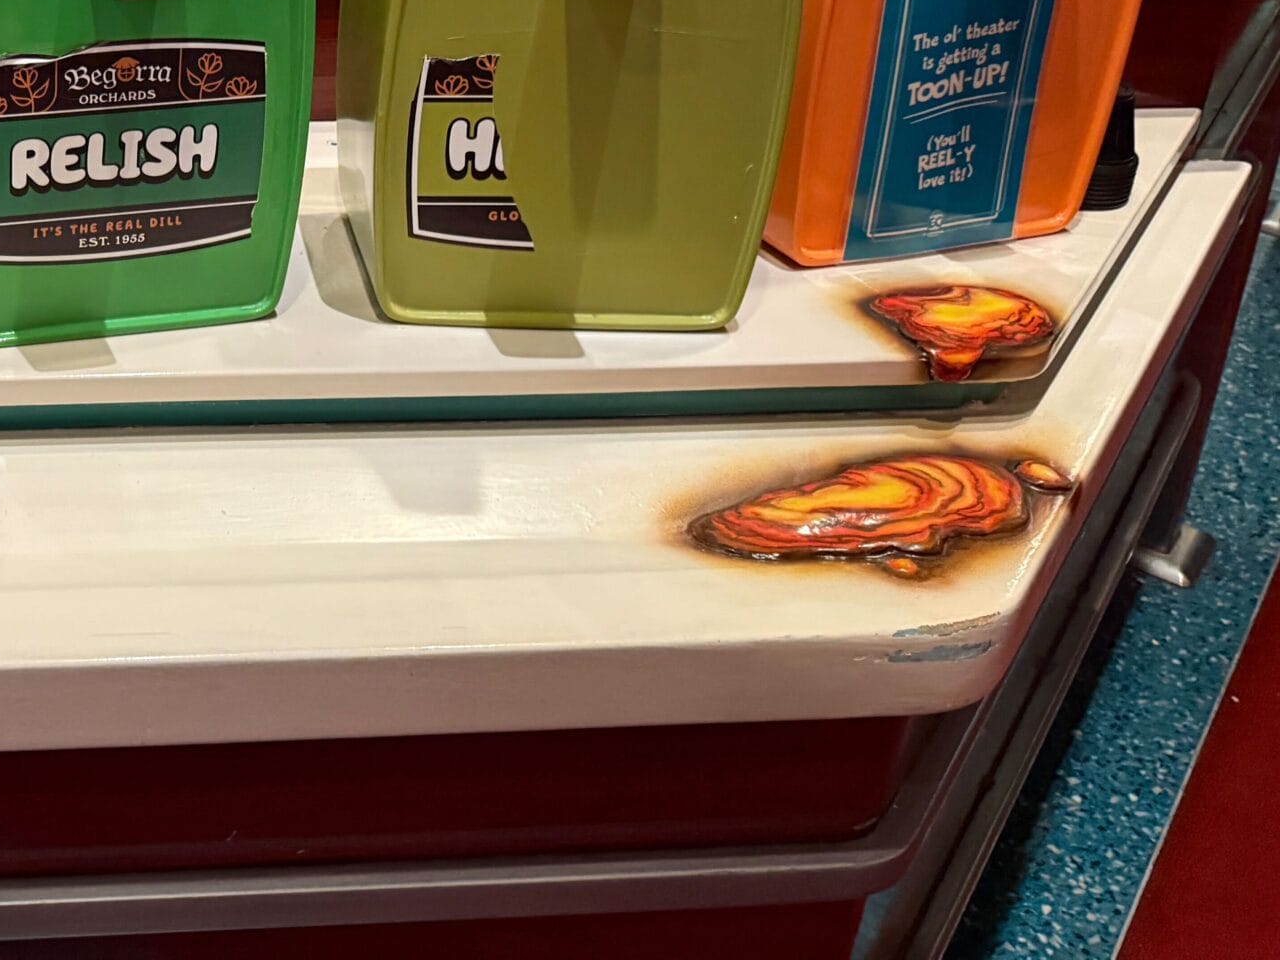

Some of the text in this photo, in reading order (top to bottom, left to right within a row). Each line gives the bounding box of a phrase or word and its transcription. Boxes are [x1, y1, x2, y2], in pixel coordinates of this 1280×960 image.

[913, 32, 939, 52] The
[966, 18, 1020, 40] theater
[922, 43, 1001, 75] is getting a
[79, 89, 156, 105] ORCHARDS
[907, 60, 1009, 106] TOON-UP!
[10, 123, 218, 194] RELISH
[917, 144, 976, 173] REEL-Y
[918, 173, 945, 190] love
[32, 215, 183, 239] IT'S THE REAL DILL
[79, 233, 146, 249] EST. 1955
